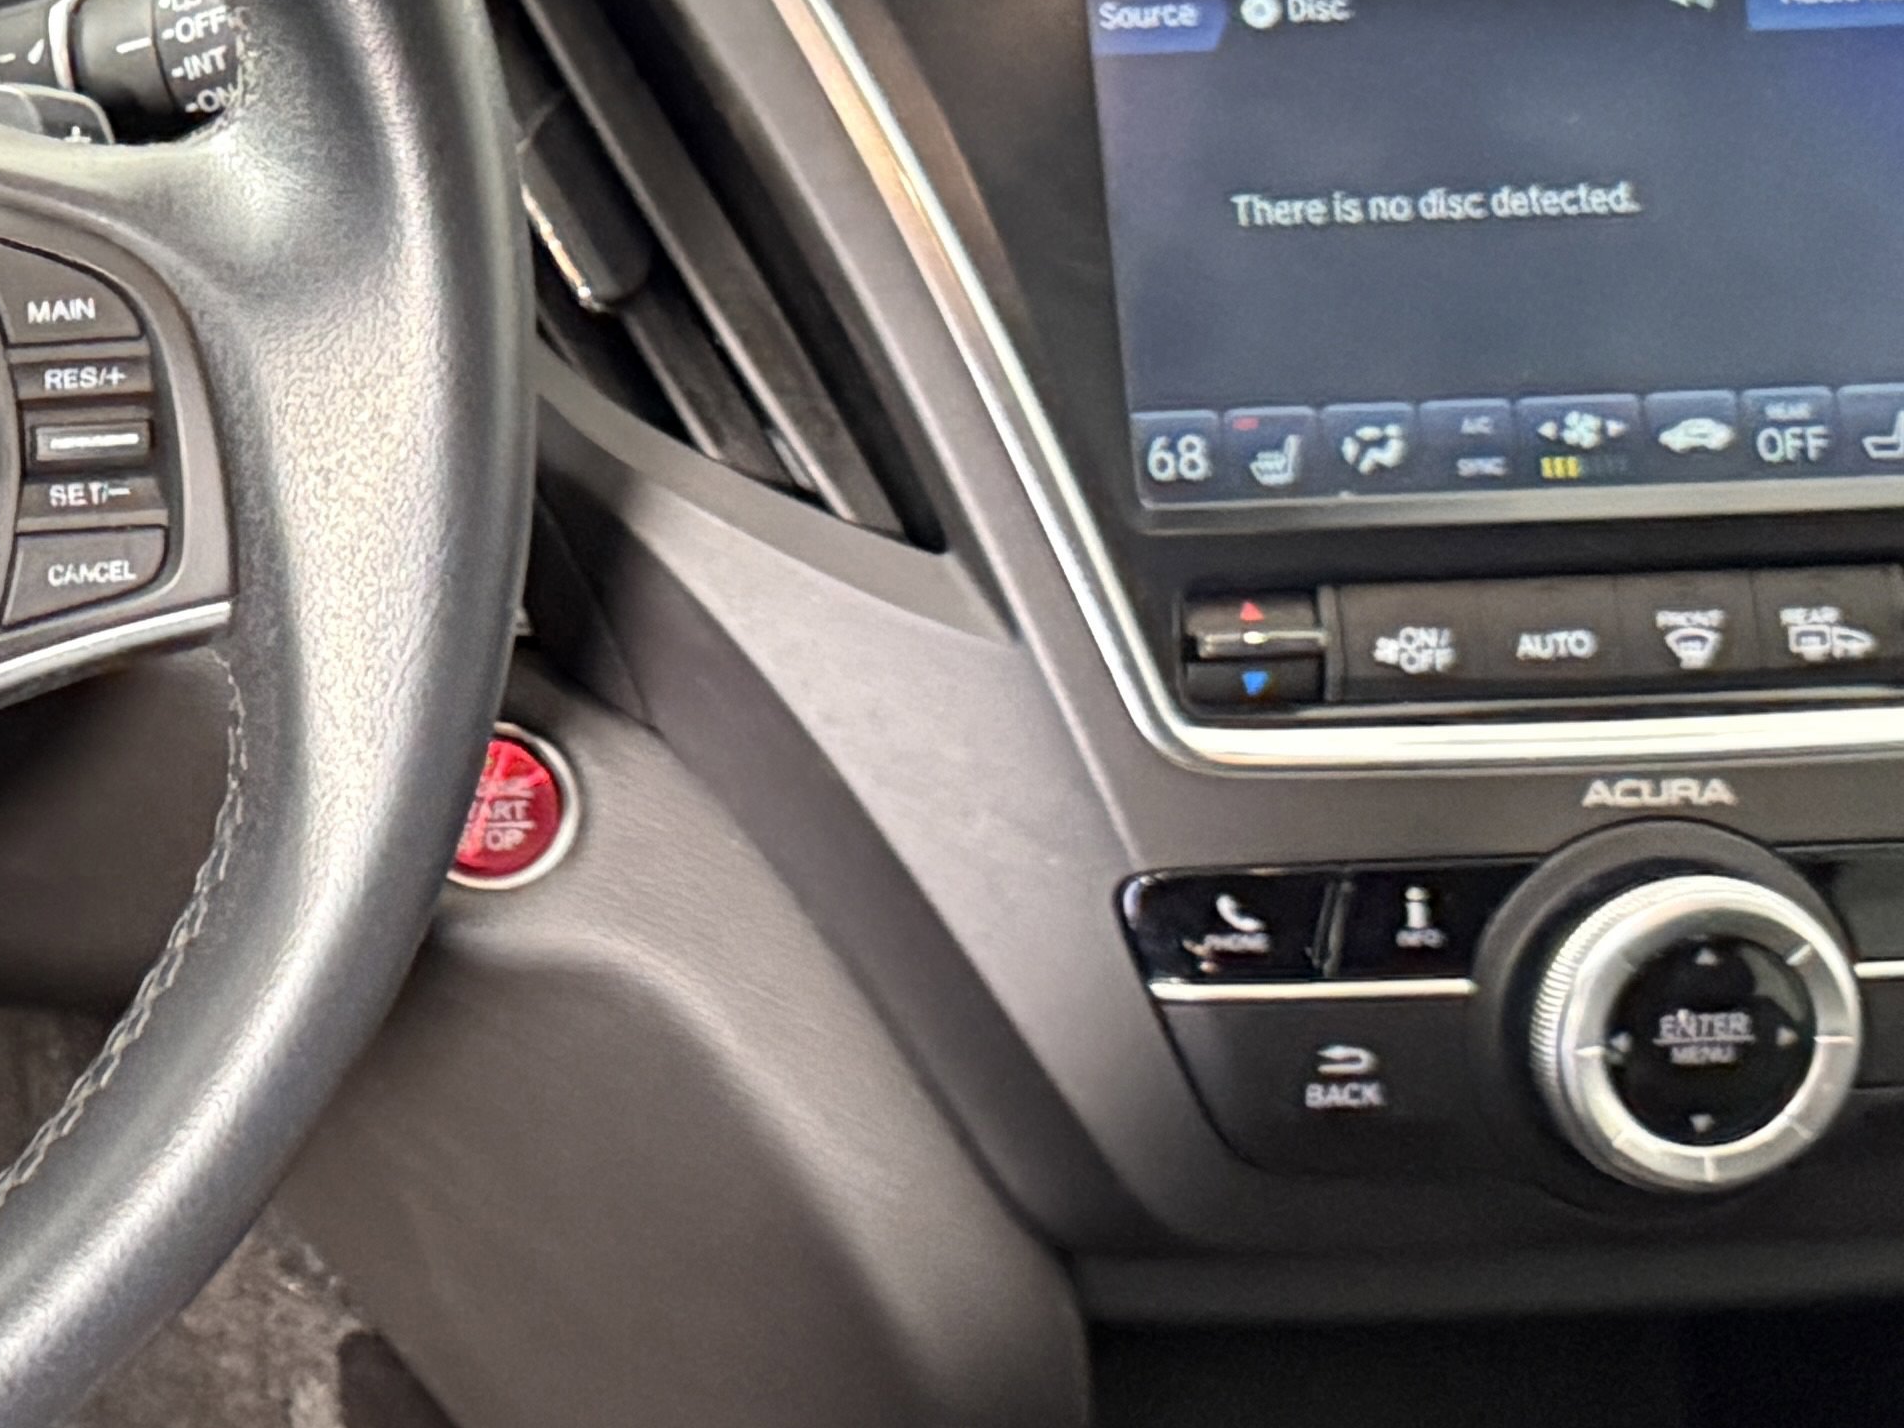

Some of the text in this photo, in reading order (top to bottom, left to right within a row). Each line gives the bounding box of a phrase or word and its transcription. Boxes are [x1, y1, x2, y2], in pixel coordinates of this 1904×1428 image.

[173, 4, 229, 43] OFF
[1099, 0, 1201, 33] Source
[183, 47, 229, 81] INT
[1230, 181, 1642, 227] There is no disc detected.
[27, 297, 96, 323] MAIN
[44, 365, 128, 391] RES/+
[1147, 433, 1212, 483] 68
[1756, 425, 1832, 463] OFF
[47, 560, 138, 587] CANCEL
[1780, 606, 1843, 626] REAR
[1516, 628, 1598, 662] AUTO
[1398, 649, 1457, 674] OFF
[1581, 778, 1739, 808] ACURA
[1658, 1011, 1753, 1039] ENTER
[1669, 1044, 1739, 1066] MENU
[1304, 1081, 1389, 1109] BACK
